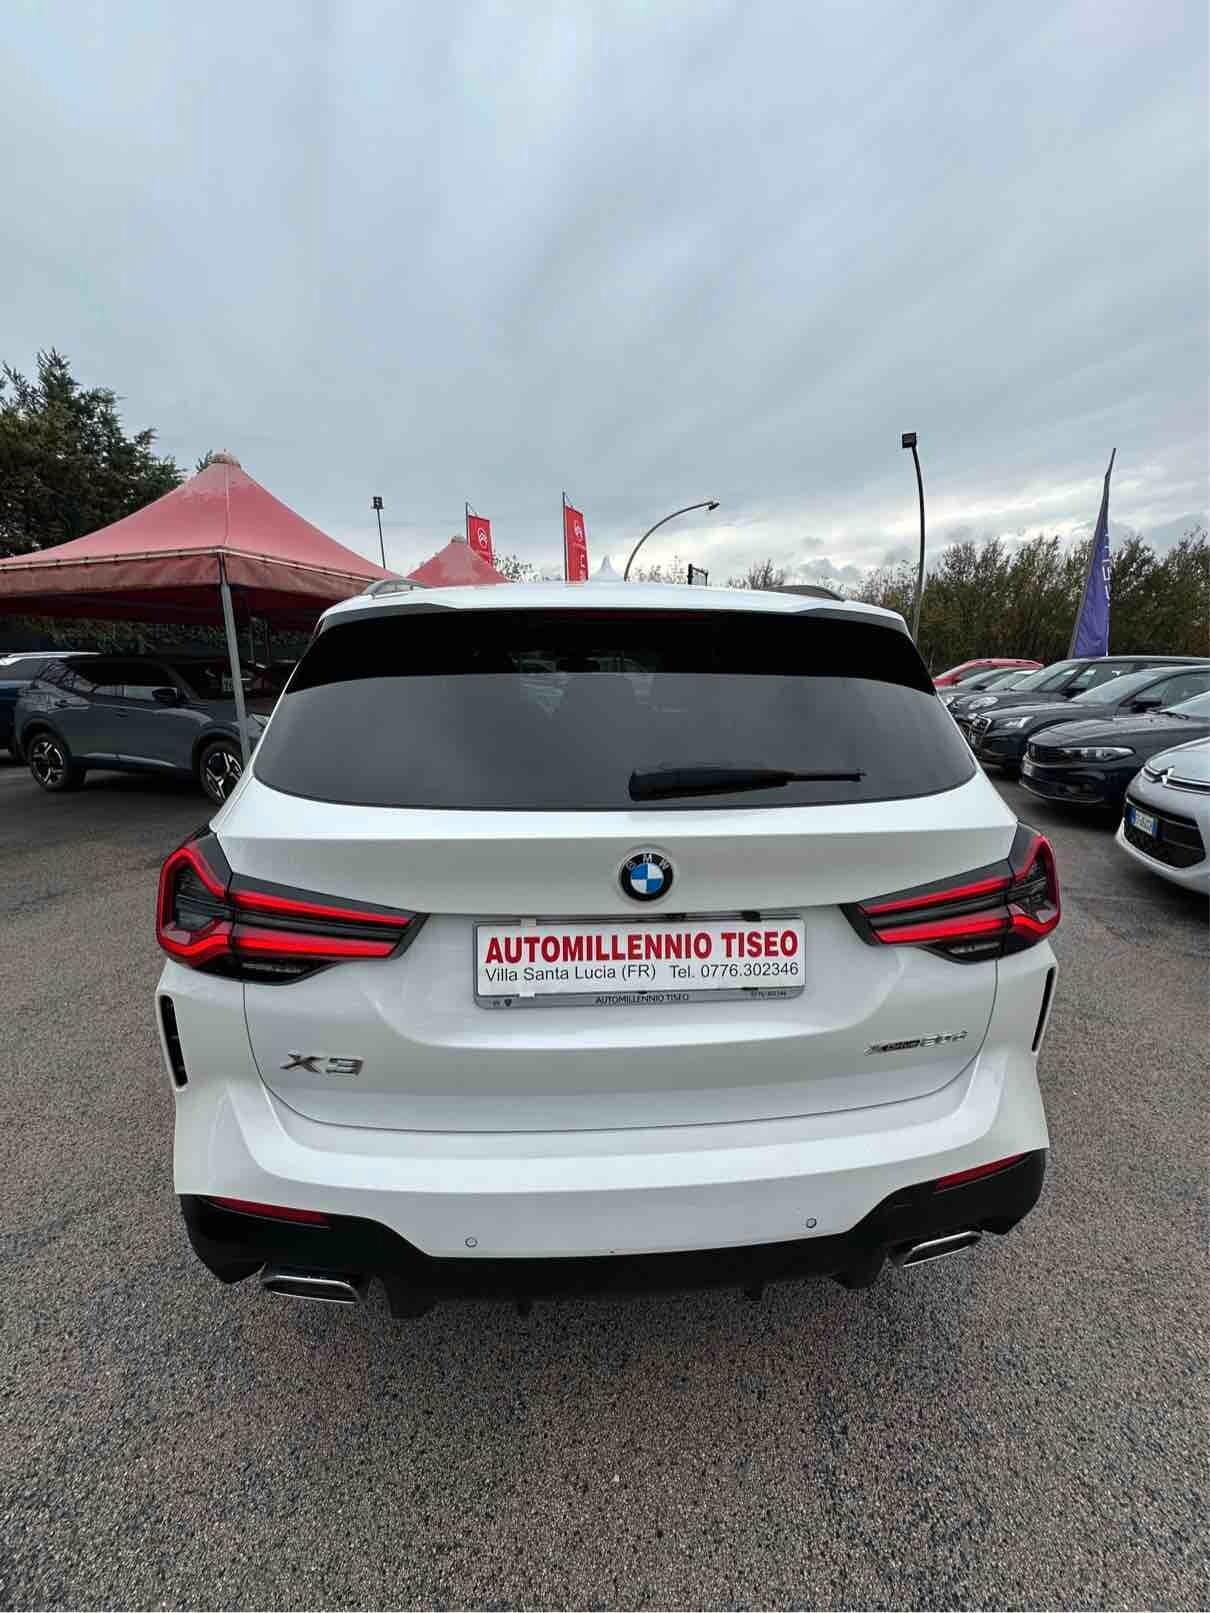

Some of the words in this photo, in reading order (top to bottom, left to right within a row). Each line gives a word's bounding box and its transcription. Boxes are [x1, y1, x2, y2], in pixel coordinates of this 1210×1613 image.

[485, 932, 712, 964] AUTOMILLENNIO
[721, 930, 798, 958] TISEO
[485, 967, 518, 982] Villa
[524, 966, 569, 981] Santa
[575, 964, 616, 980] Lucia
[622, 963, 656, 981] (FR)
[670, 965, 695, 979] Tel.
[700, 962, 799, 978] 0776.302346
[280, 1053, 364, 1077] X3
